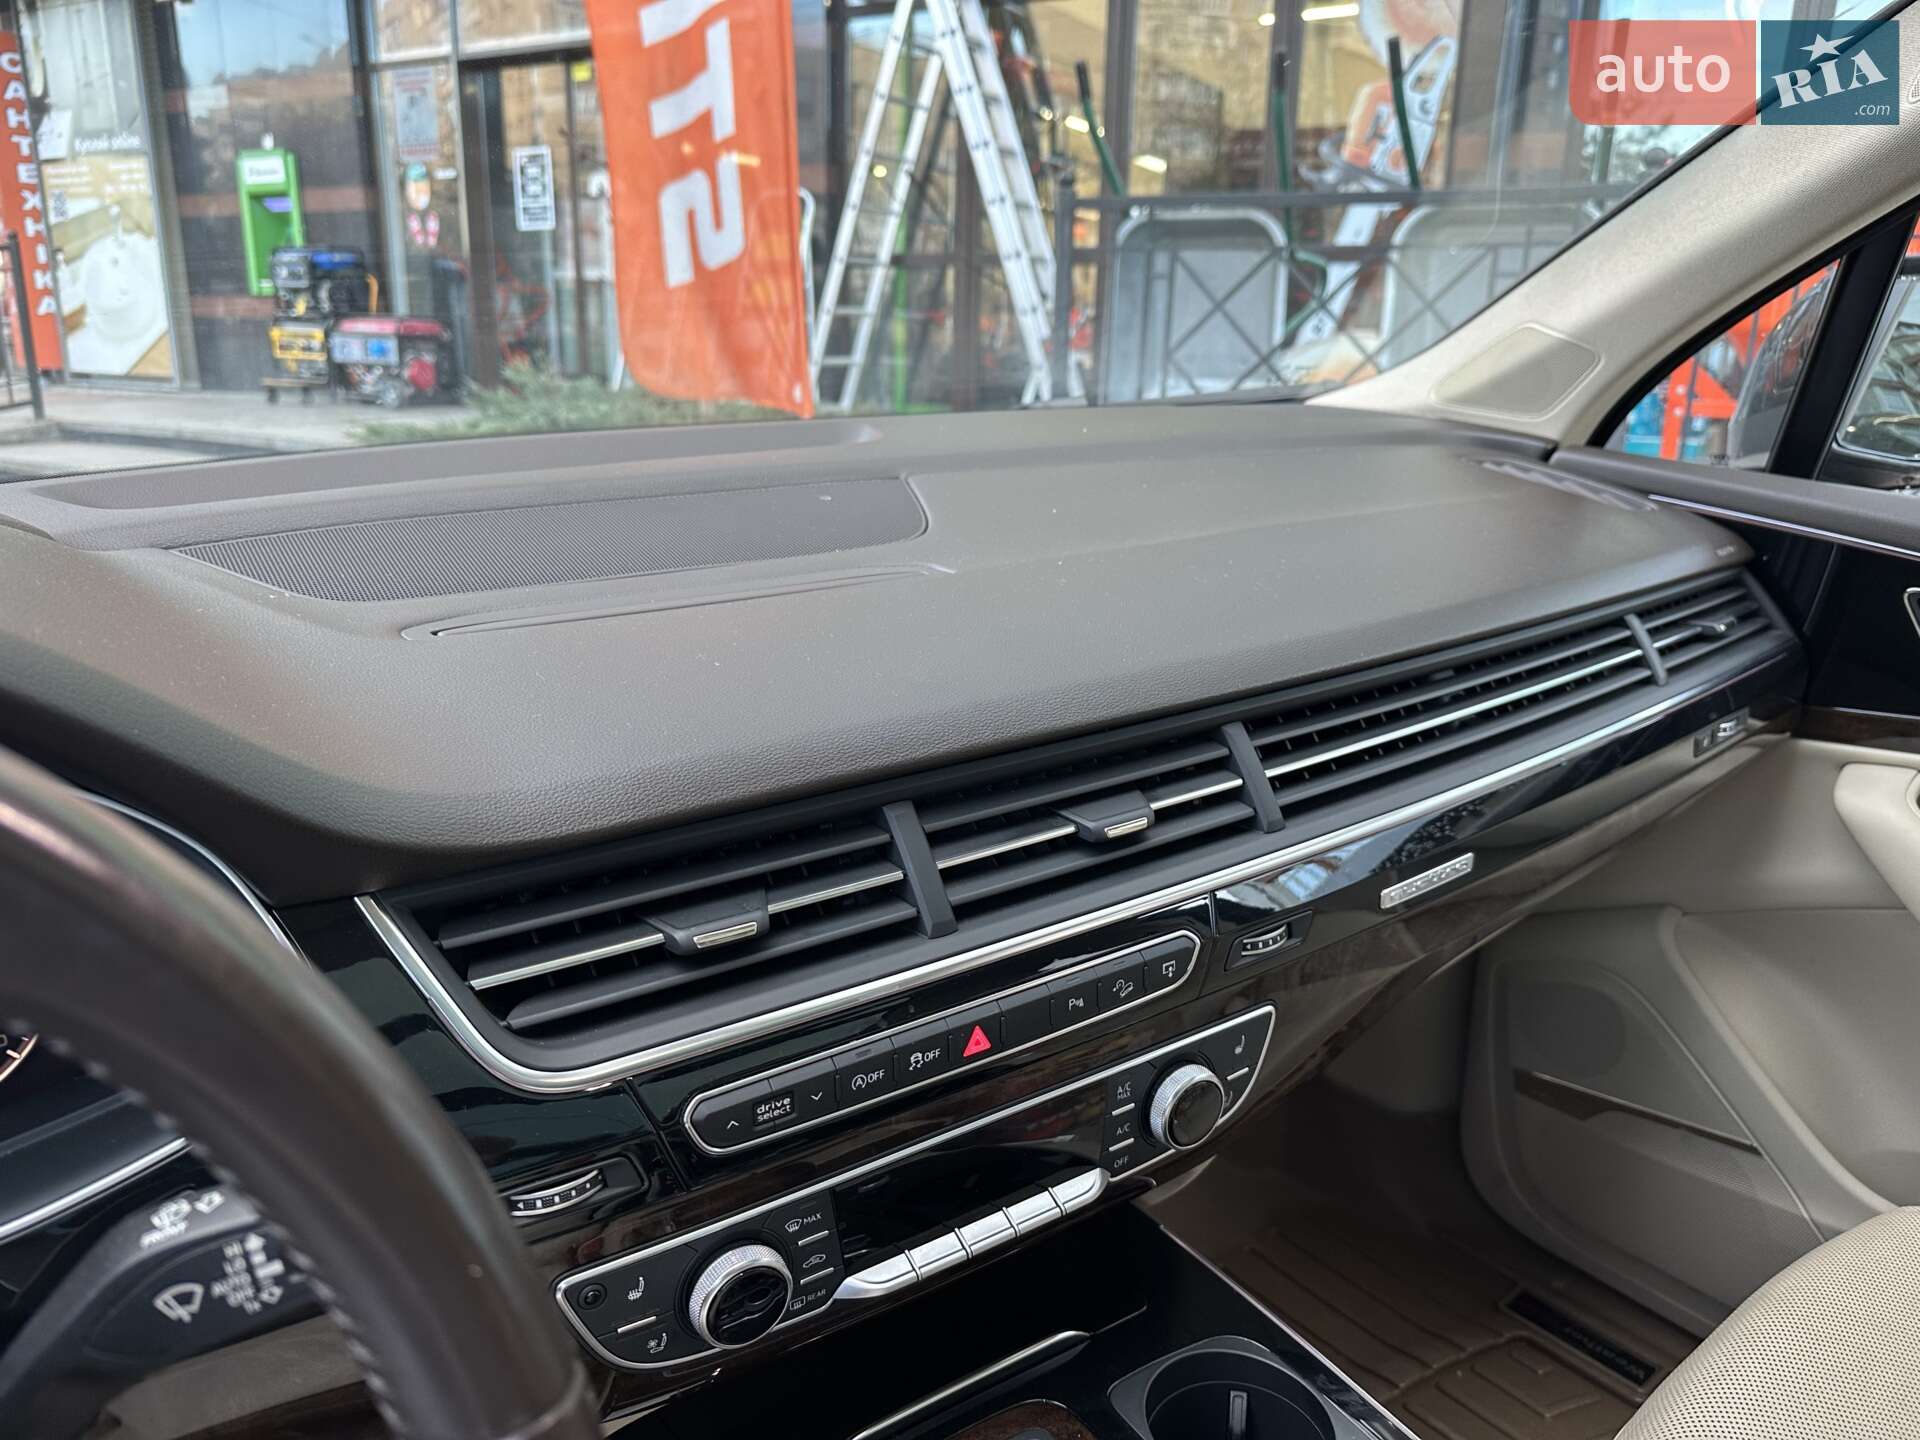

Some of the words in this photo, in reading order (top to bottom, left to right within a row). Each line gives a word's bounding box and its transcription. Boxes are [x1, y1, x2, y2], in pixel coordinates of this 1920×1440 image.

[0, 51, 57, 316] САНТЕХНІКА
[924, 1048, 942, 1062] OFF
[867, 1069, 886, 1084] OFF
[756, 1096, 792, 1115] drive
[757, 1105, 792, 1122] select
[1116, 1122, 1131, 1136] A/C
[1113, 1155, 1129, 1169] OFF
[803, 1212, 822, 1225] MAX
